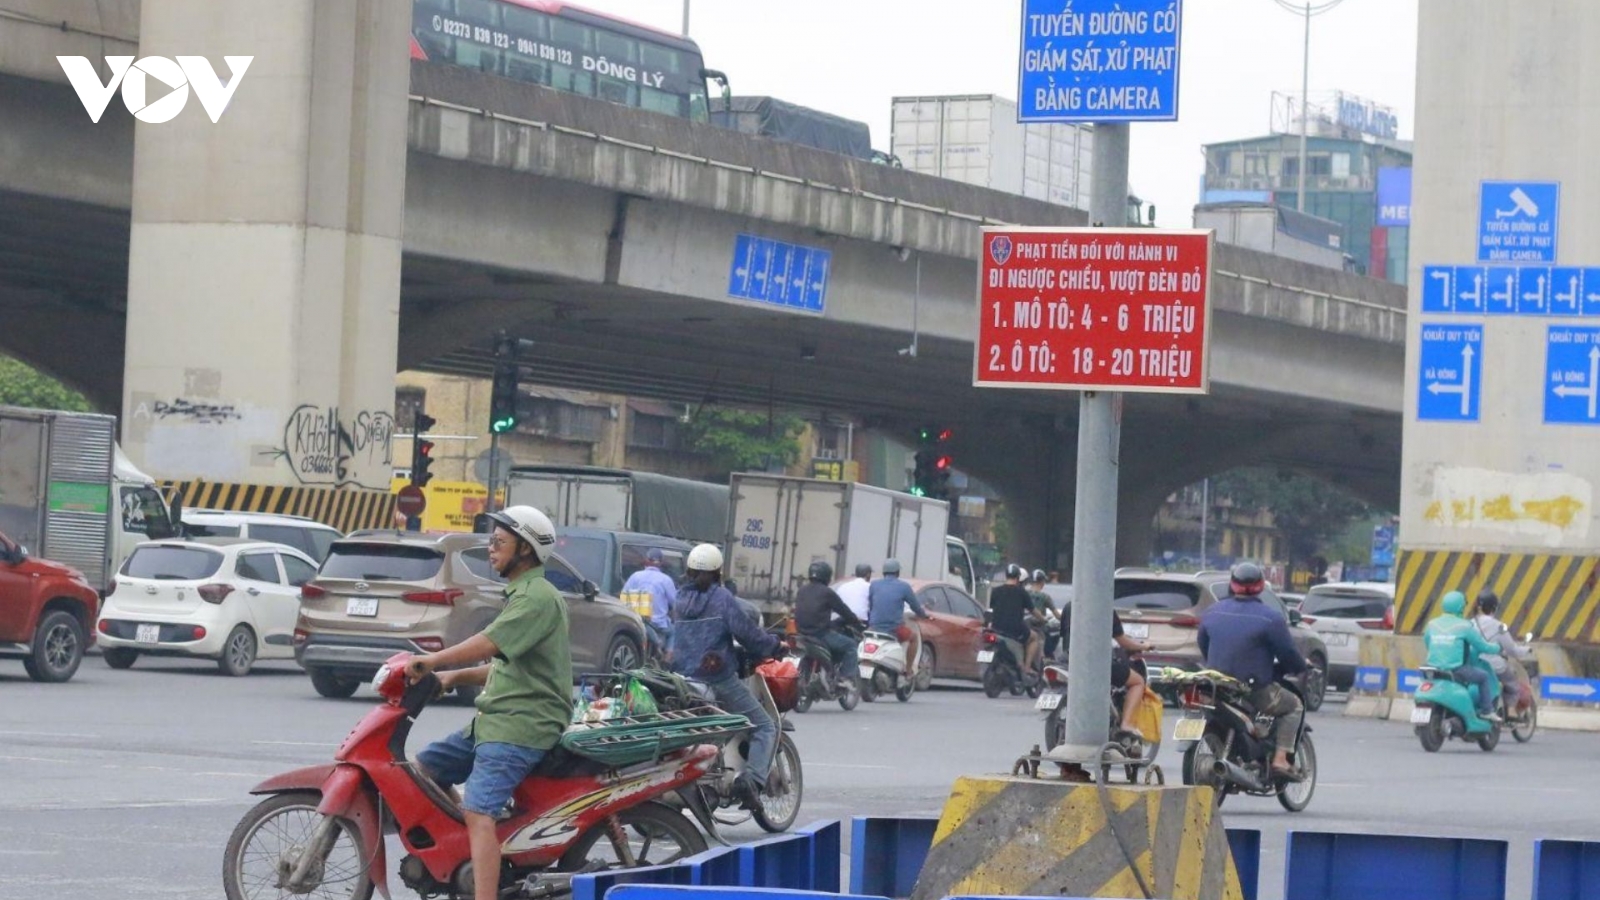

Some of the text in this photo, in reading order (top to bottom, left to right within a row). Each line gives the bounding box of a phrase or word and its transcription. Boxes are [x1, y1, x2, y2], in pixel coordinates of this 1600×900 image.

[1030, 1, 1175, 36] TUYẾN ĐƯỜNG CÓ
[443, 18, 471, 39] 02373
[474, 25, 491, 44] 839
[493, 32, 509, 49] 123
[517, 37, 538, 57] 0941
[557, 49, 572, 66] 123
[1025, 42, 1067, 72] GIÁM
[1133, 47, 1175, 75] PHẠT
[581, 56, 665, 89] ĐÔNG LÝ
[1035, 76, 1161, 111] BẰNG CAMERA
[1016, 243, 1047, 262] PHẠT
[1051, 238, 1077, 260] TIỀN
[1080, 239, 1101, 260] ĐỐI
[1105, 241, 1125, 260] VỚI
[1128, 241, 1163, 261] HÀNH
[1166, 245, 1177, 261] VI
[989, 264, 1201, 295] ĐI NGƯỢC CHIỀU, VƯỢT ĐÈN ĐỎ
[993, 301, 1007, 328] 1.
[1013, 296, 1041, 328] MÔ
[1048, 297, 1074, 329] TÔ:
[1081, 303, 1092, 330] 4
[1117, 304, 1128, 332] 6
[1143, 300, 1195, 338] TRIỆU
[989, 345, 1005, 372] 2.
[1011, 339, 1023, 373] Ô
[1029, 340, 1056, 373] TÔ:
[1073, 347, 1093, 374] 18
[1110, 348, 1134, 376] 20
[1140, 344, 1192, 383] TRIỆU
[746, 519, 763, 532] 29C
